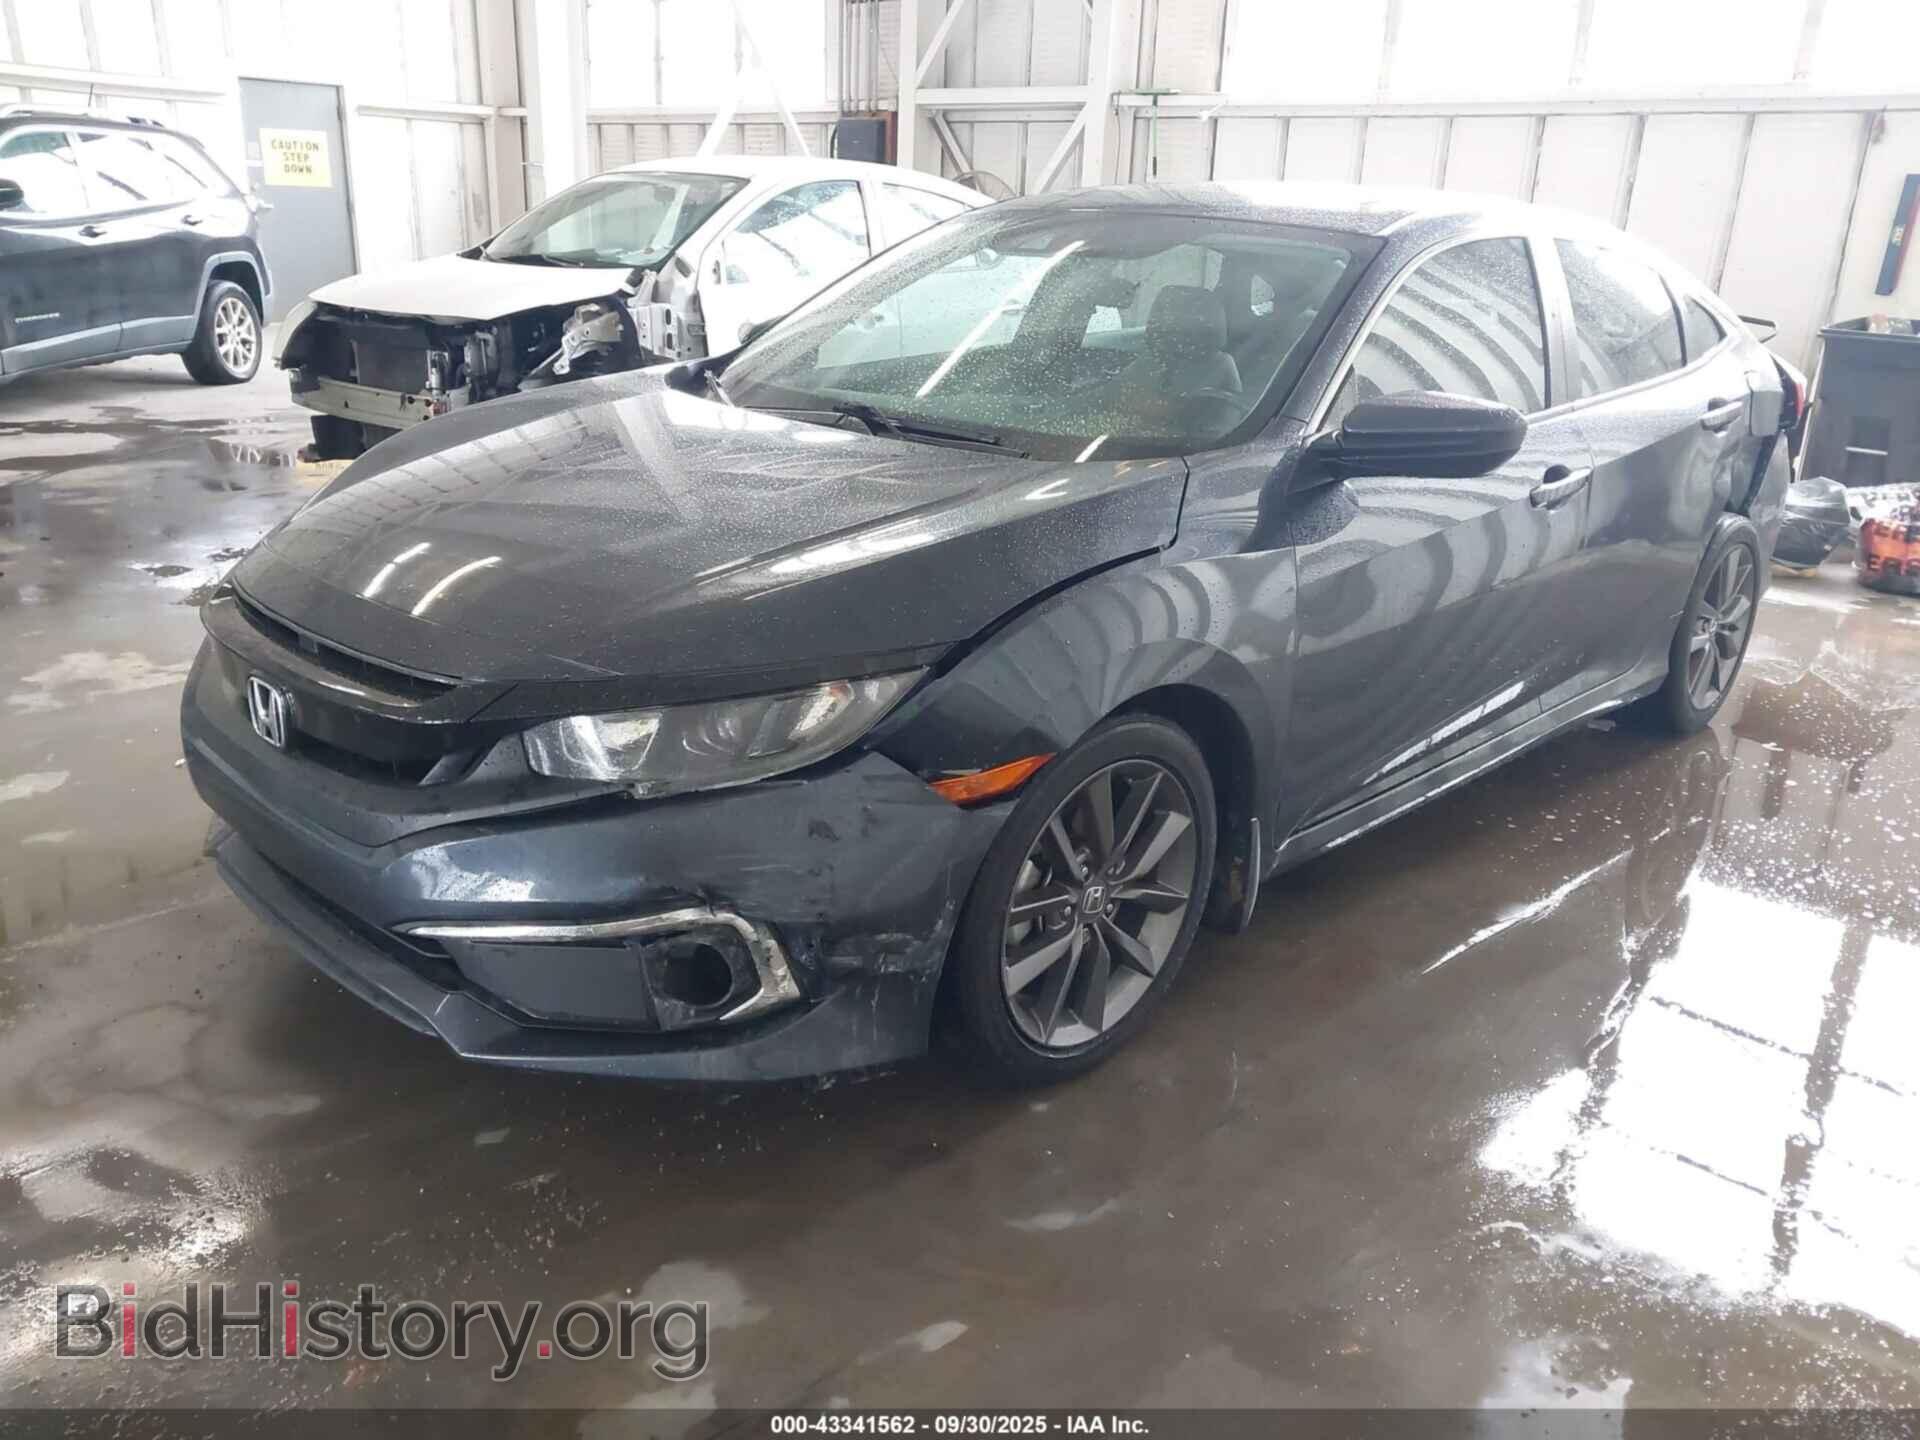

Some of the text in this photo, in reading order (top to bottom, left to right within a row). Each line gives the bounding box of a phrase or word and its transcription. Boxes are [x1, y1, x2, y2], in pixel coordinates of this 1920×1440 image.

[271, 139, 319, 152] CAUTION
[283, 152, 310, 162] STEP
[284, 164, 313, 174] DOWN
